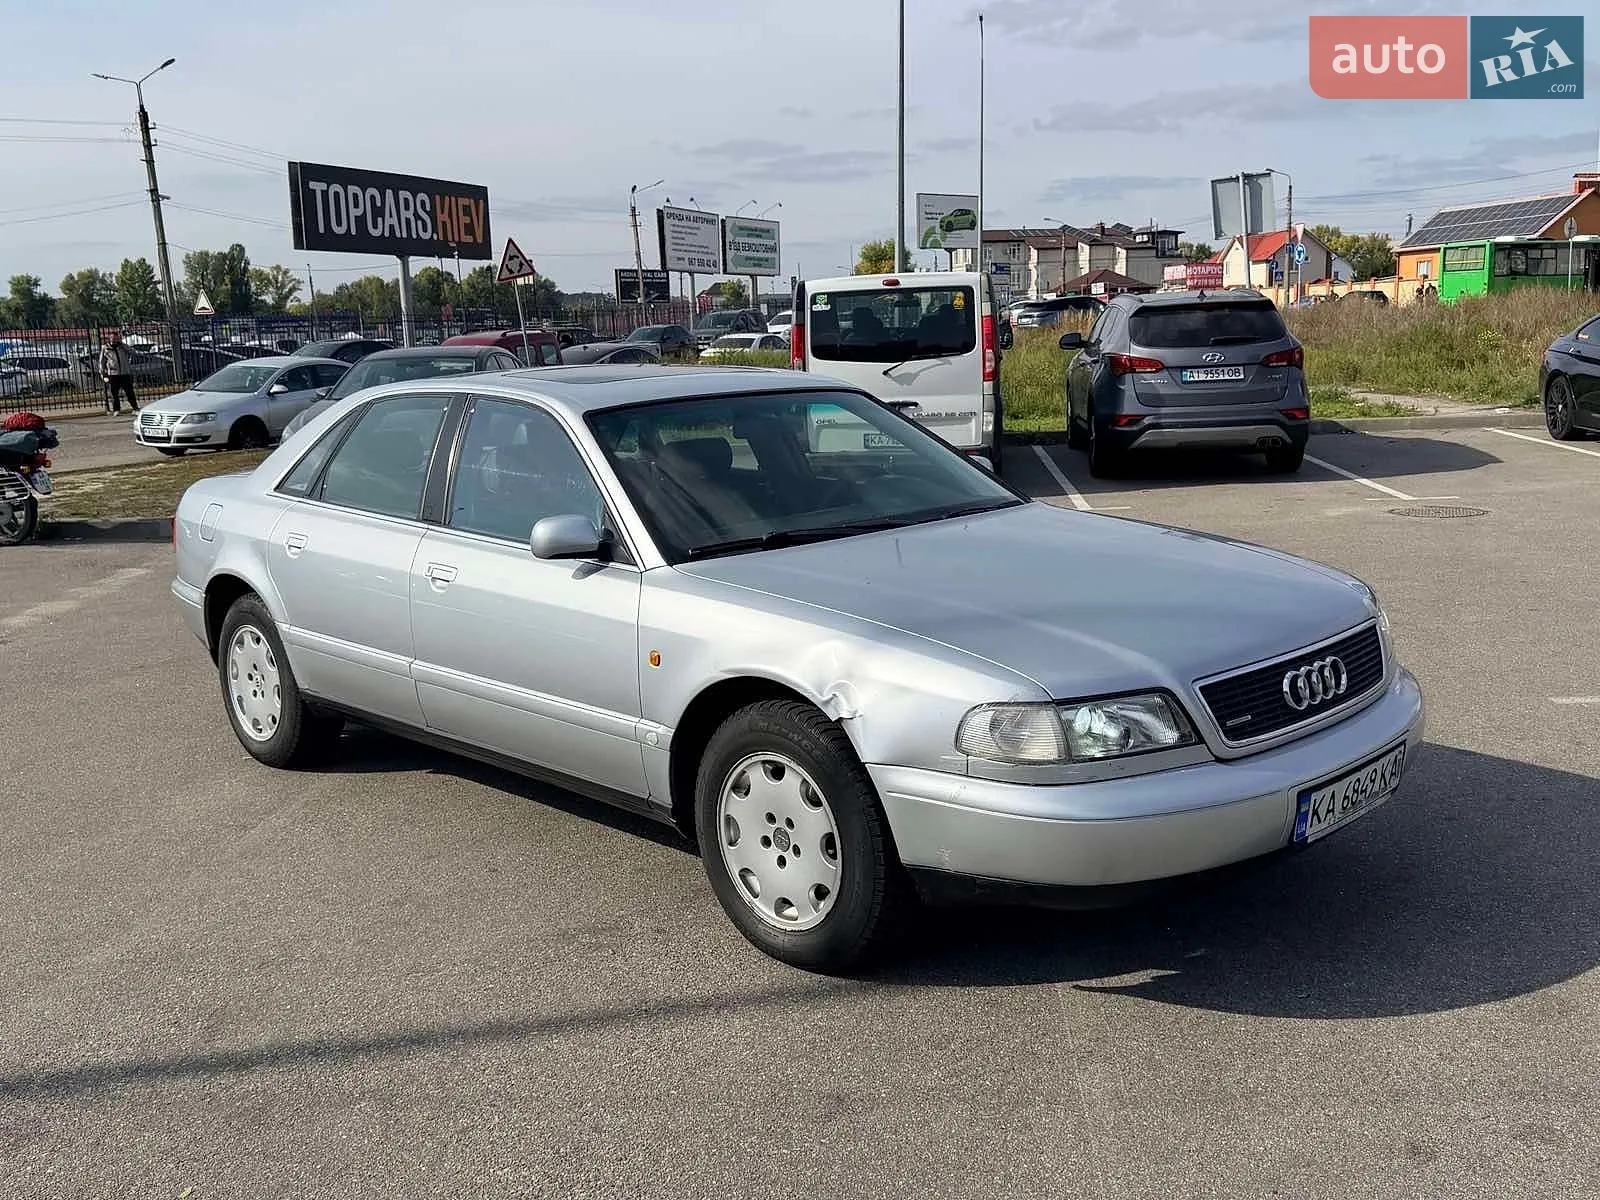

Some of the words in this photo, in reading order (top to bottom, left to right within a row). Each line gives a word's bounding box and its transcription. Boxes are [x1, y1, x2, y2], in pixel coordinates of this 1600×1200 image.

[309, 181, 485, 244] TOPCARS.KIEV
[1188, 370, 1200, 380] AI
[1203, 368, 1226, 379] 9551
[1310, 789, 1336, 828] KA
[1341, 767, 1378, 810] 6849
